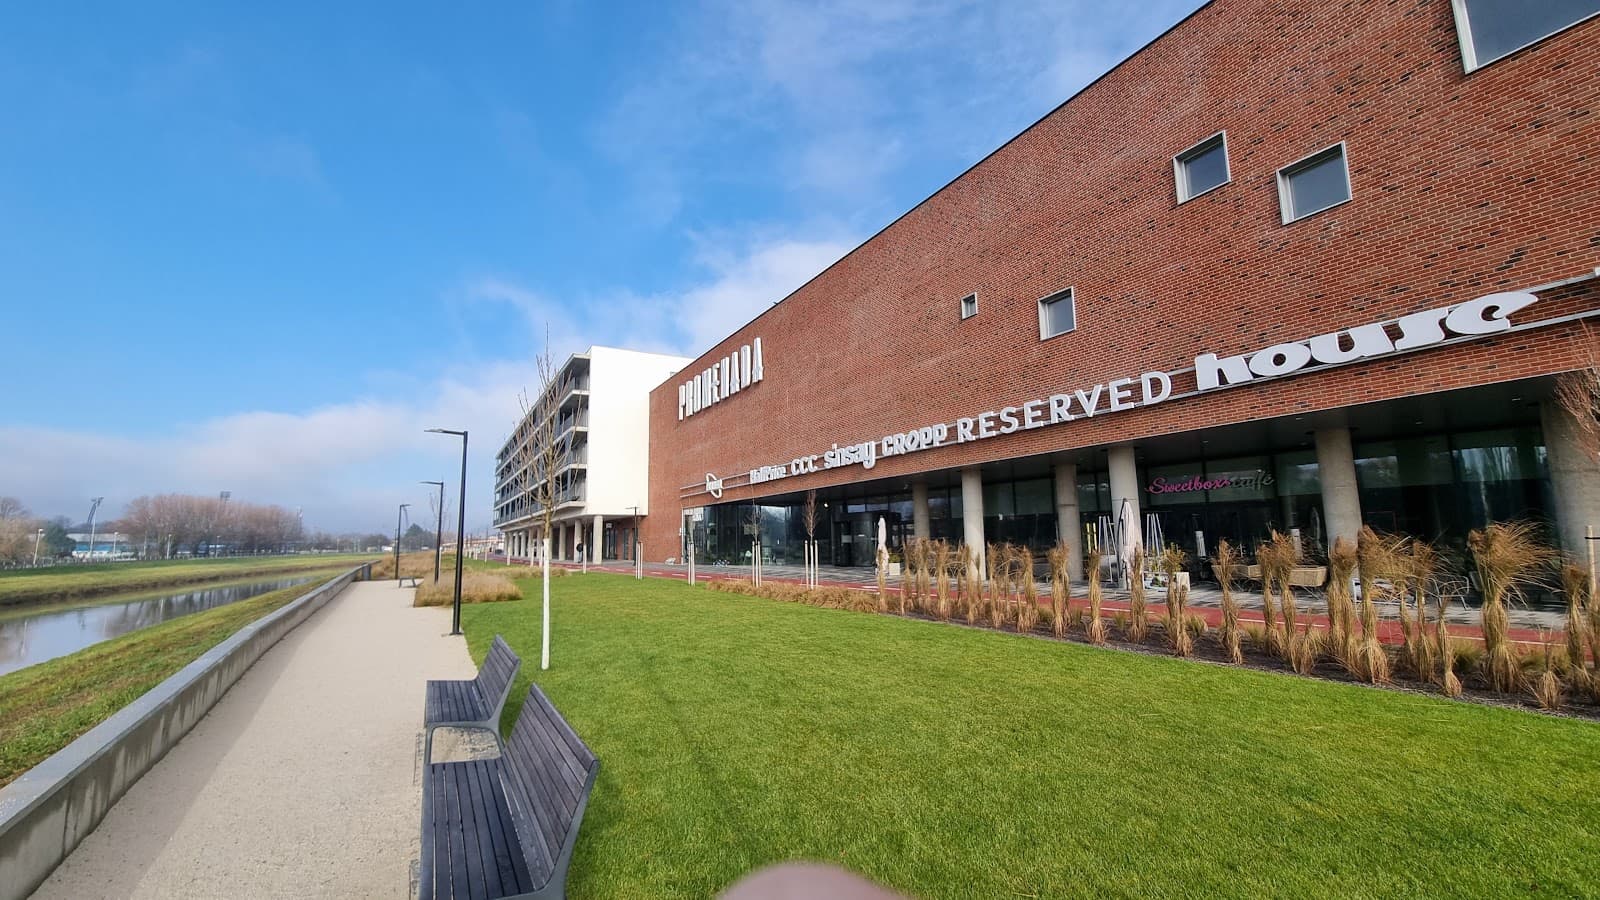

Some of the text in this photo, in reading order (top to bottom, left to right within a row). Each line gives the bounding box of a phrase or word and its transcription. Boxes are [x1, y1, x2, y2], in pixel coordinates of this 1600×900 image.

[1195, 291, 1538, 390] house
[678, 337, 763, 420] PROMENADA
[955, 370, 1172, 443] RESERVED
[791, 454, 819, 476] CCC
[823, 442, 877, 470] sinsay
[881, 423, 948, 456] CROPP
